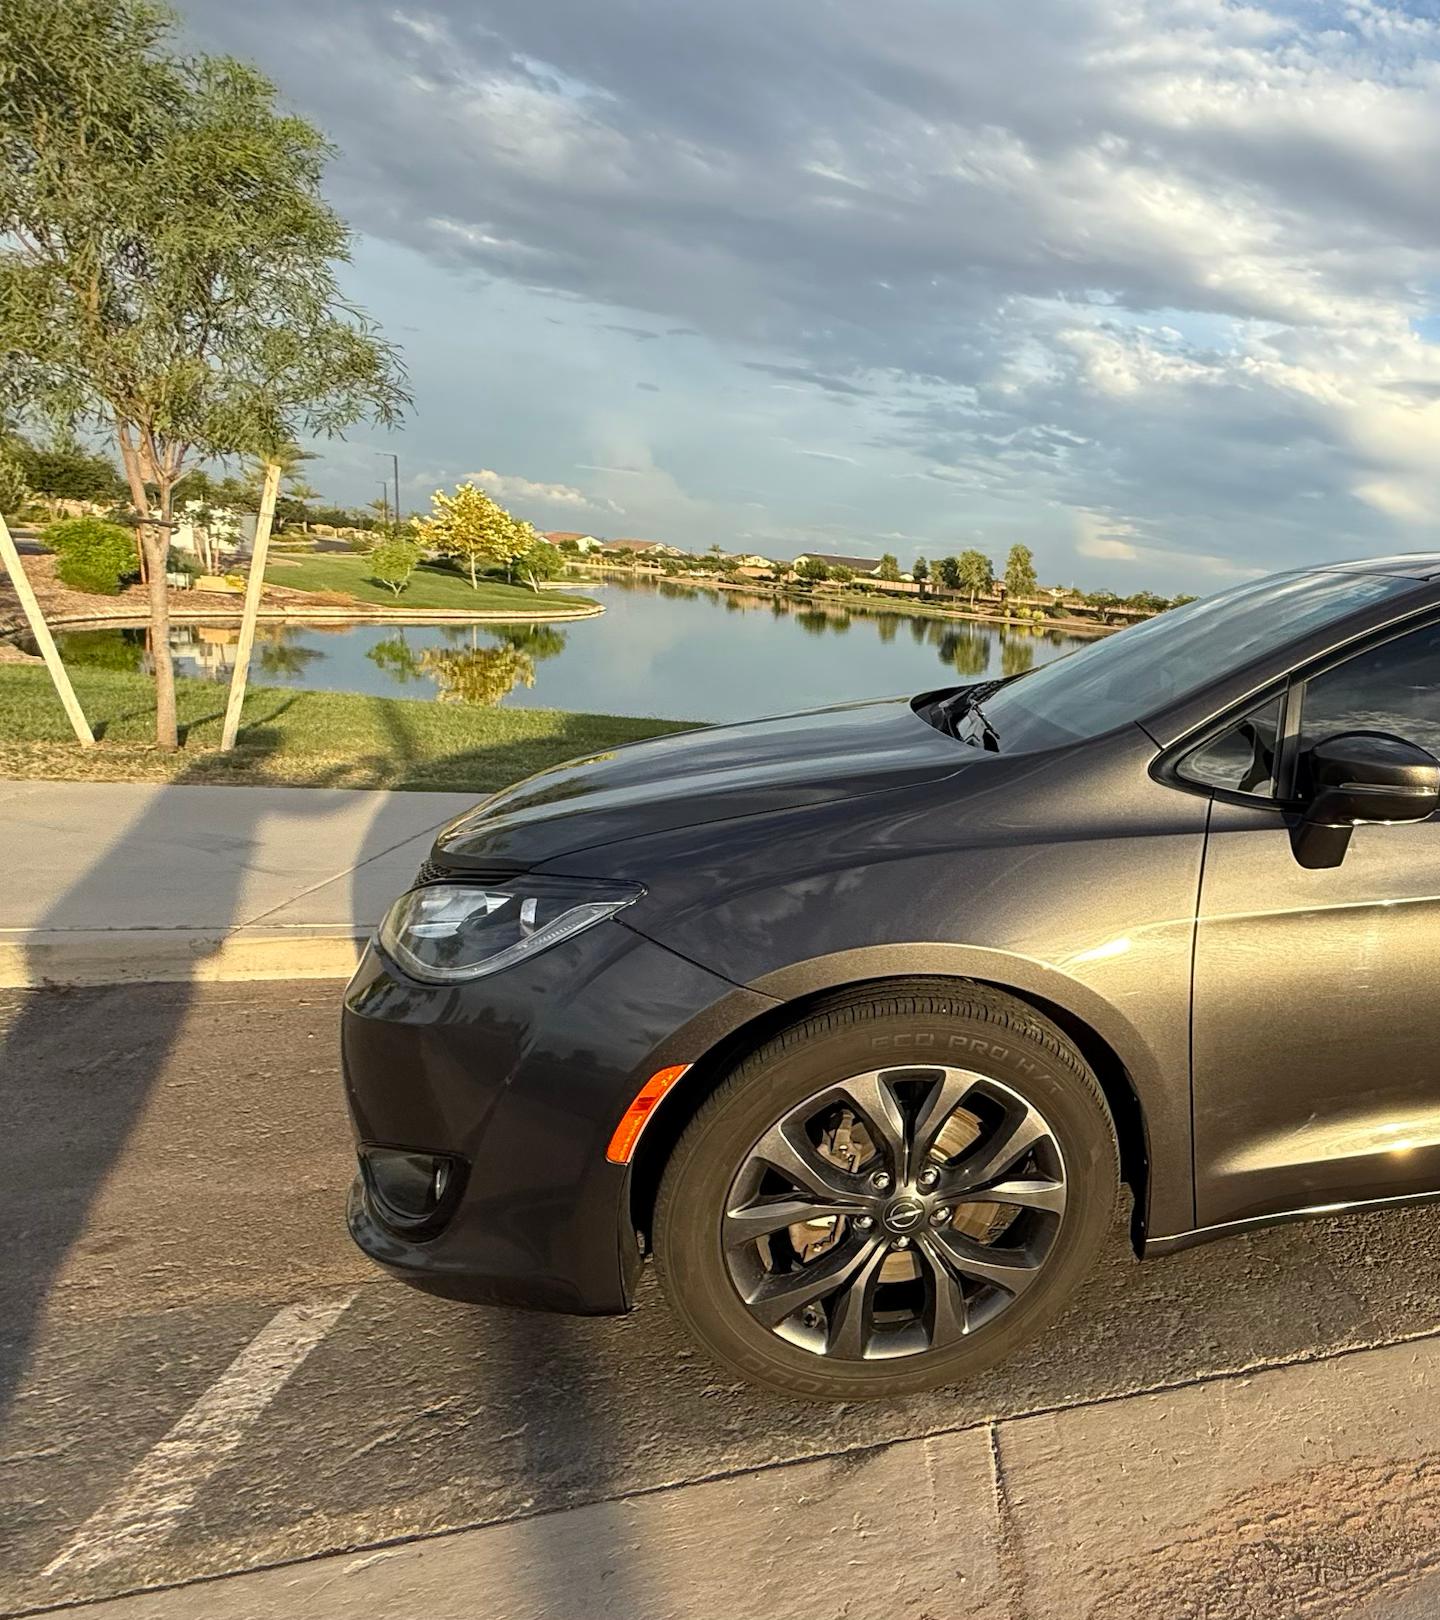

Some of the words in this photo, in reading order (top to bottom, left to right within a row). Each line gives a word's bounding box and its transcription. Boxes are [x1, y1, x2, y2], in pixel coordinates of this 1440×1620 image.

[871, 1033, 935, 1049] ECO
[949, 1034, 1009, 1059] PRO
[1015, 1057, 1064, 1095] H/T
